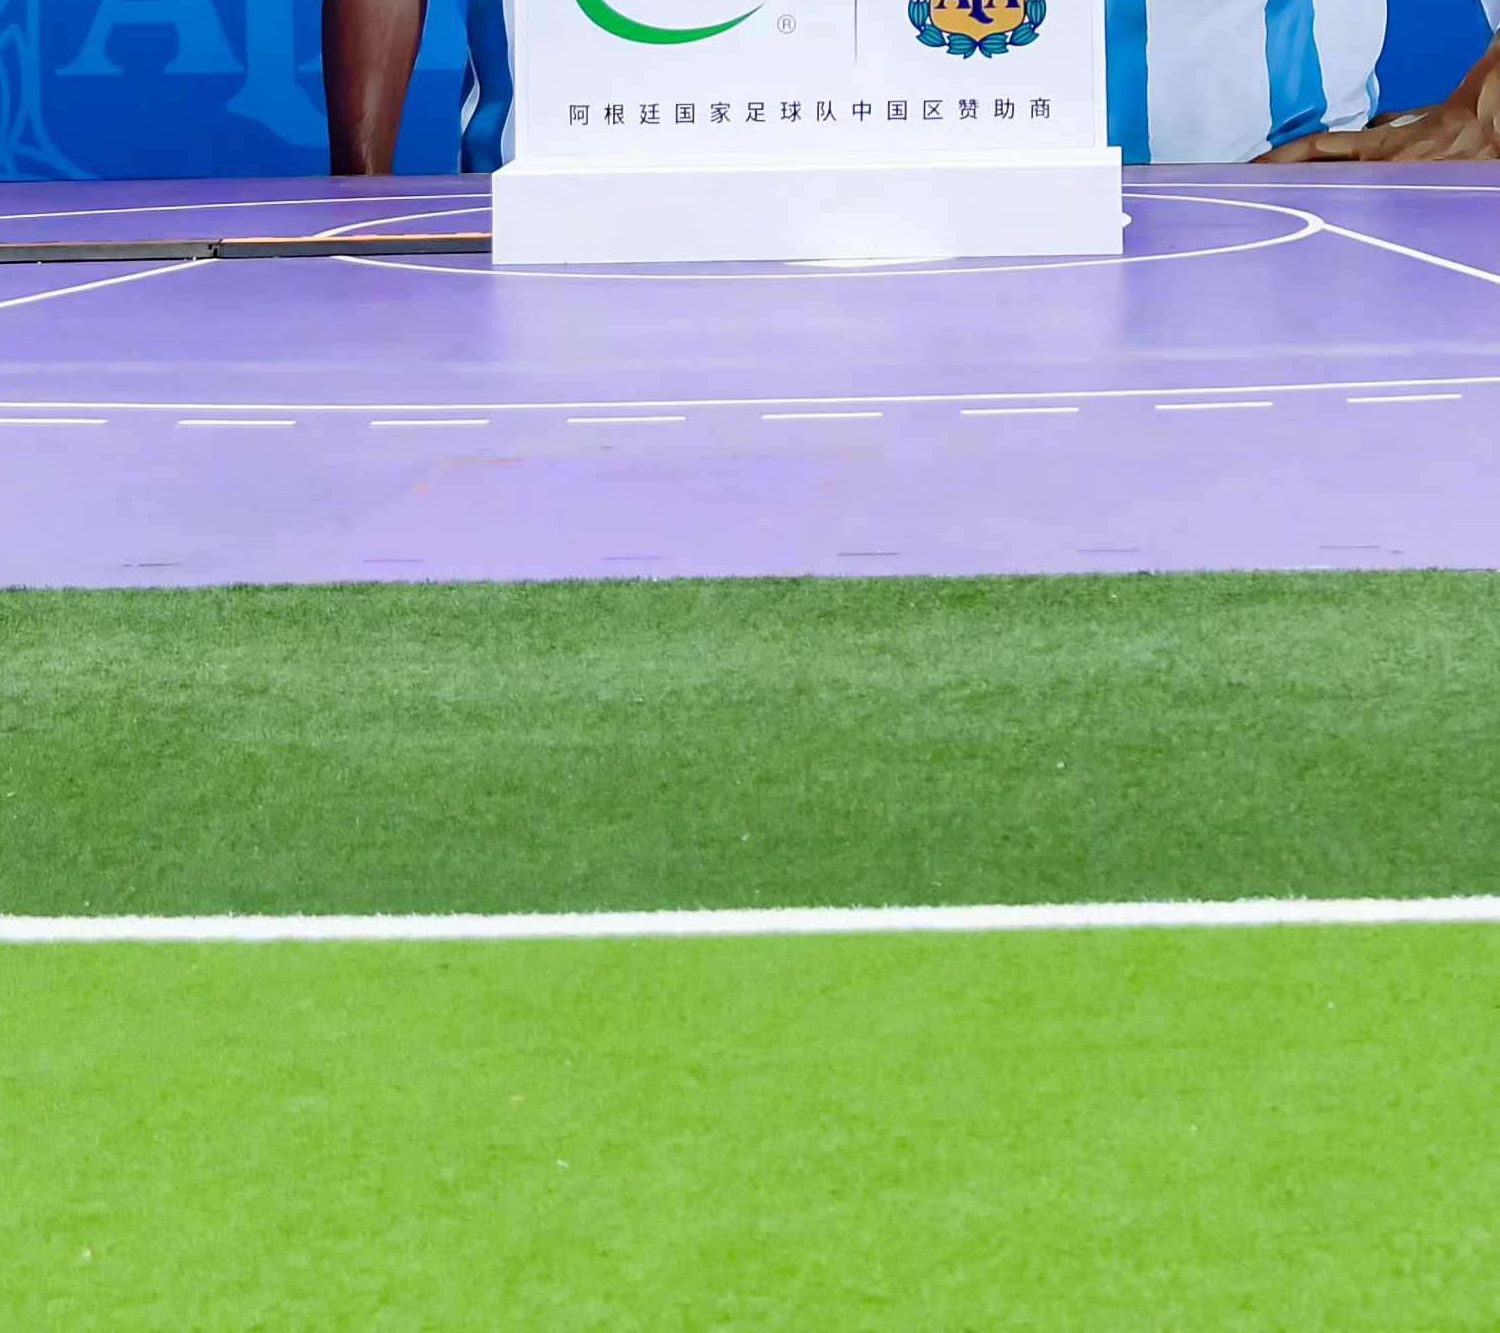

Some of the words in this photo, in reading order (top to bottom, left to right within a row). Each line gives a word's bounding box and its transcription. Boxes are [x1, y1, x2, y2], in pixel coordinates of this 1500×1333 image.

[568, 97, 1053, 126] 阿根廷国家足球队中国区赞助商
